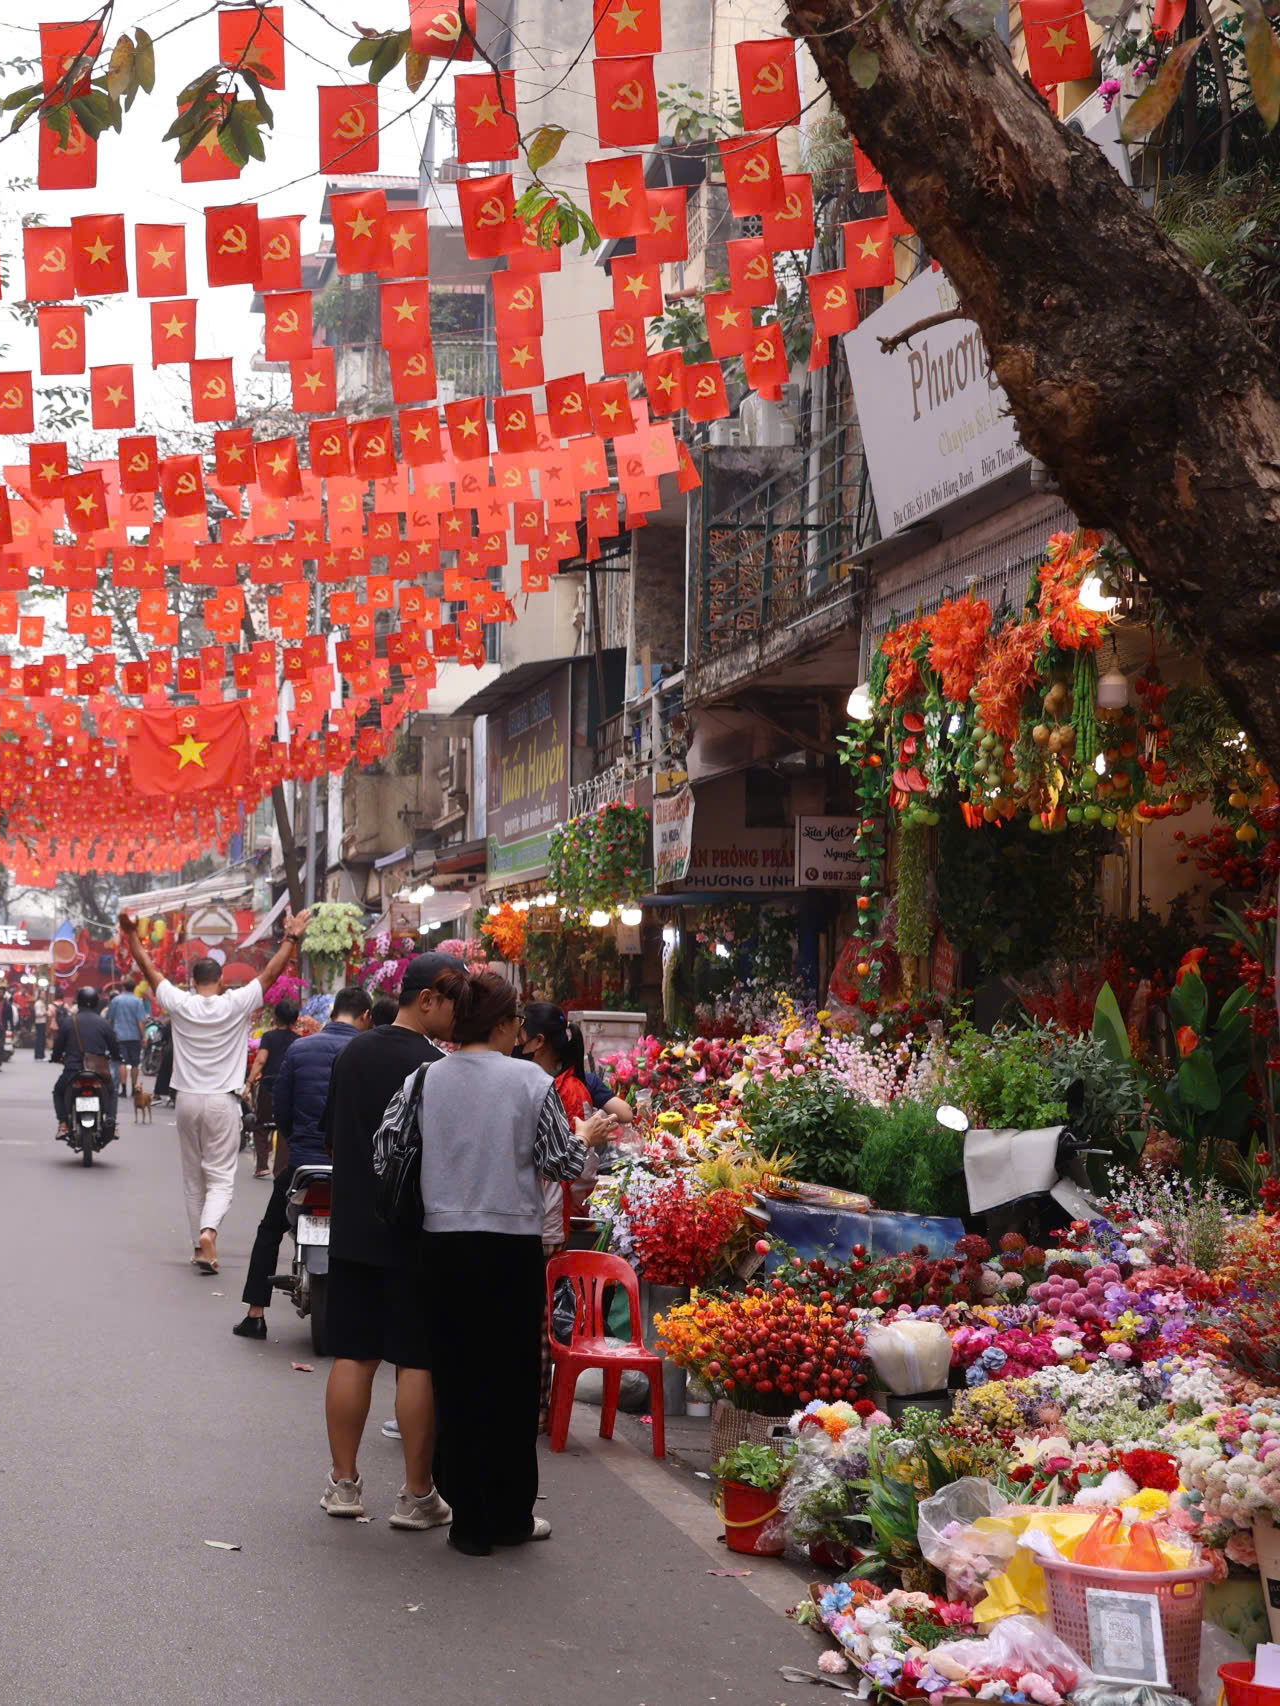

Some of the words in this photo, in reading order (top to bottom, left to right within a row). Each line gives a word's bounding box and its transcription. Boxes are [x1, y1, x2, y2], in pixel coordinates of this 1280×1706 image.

[908, 327, 1001, 422] Phươn
[527, 719, 565, 801] Huyền
[760, 876, 795, 888] LINH
